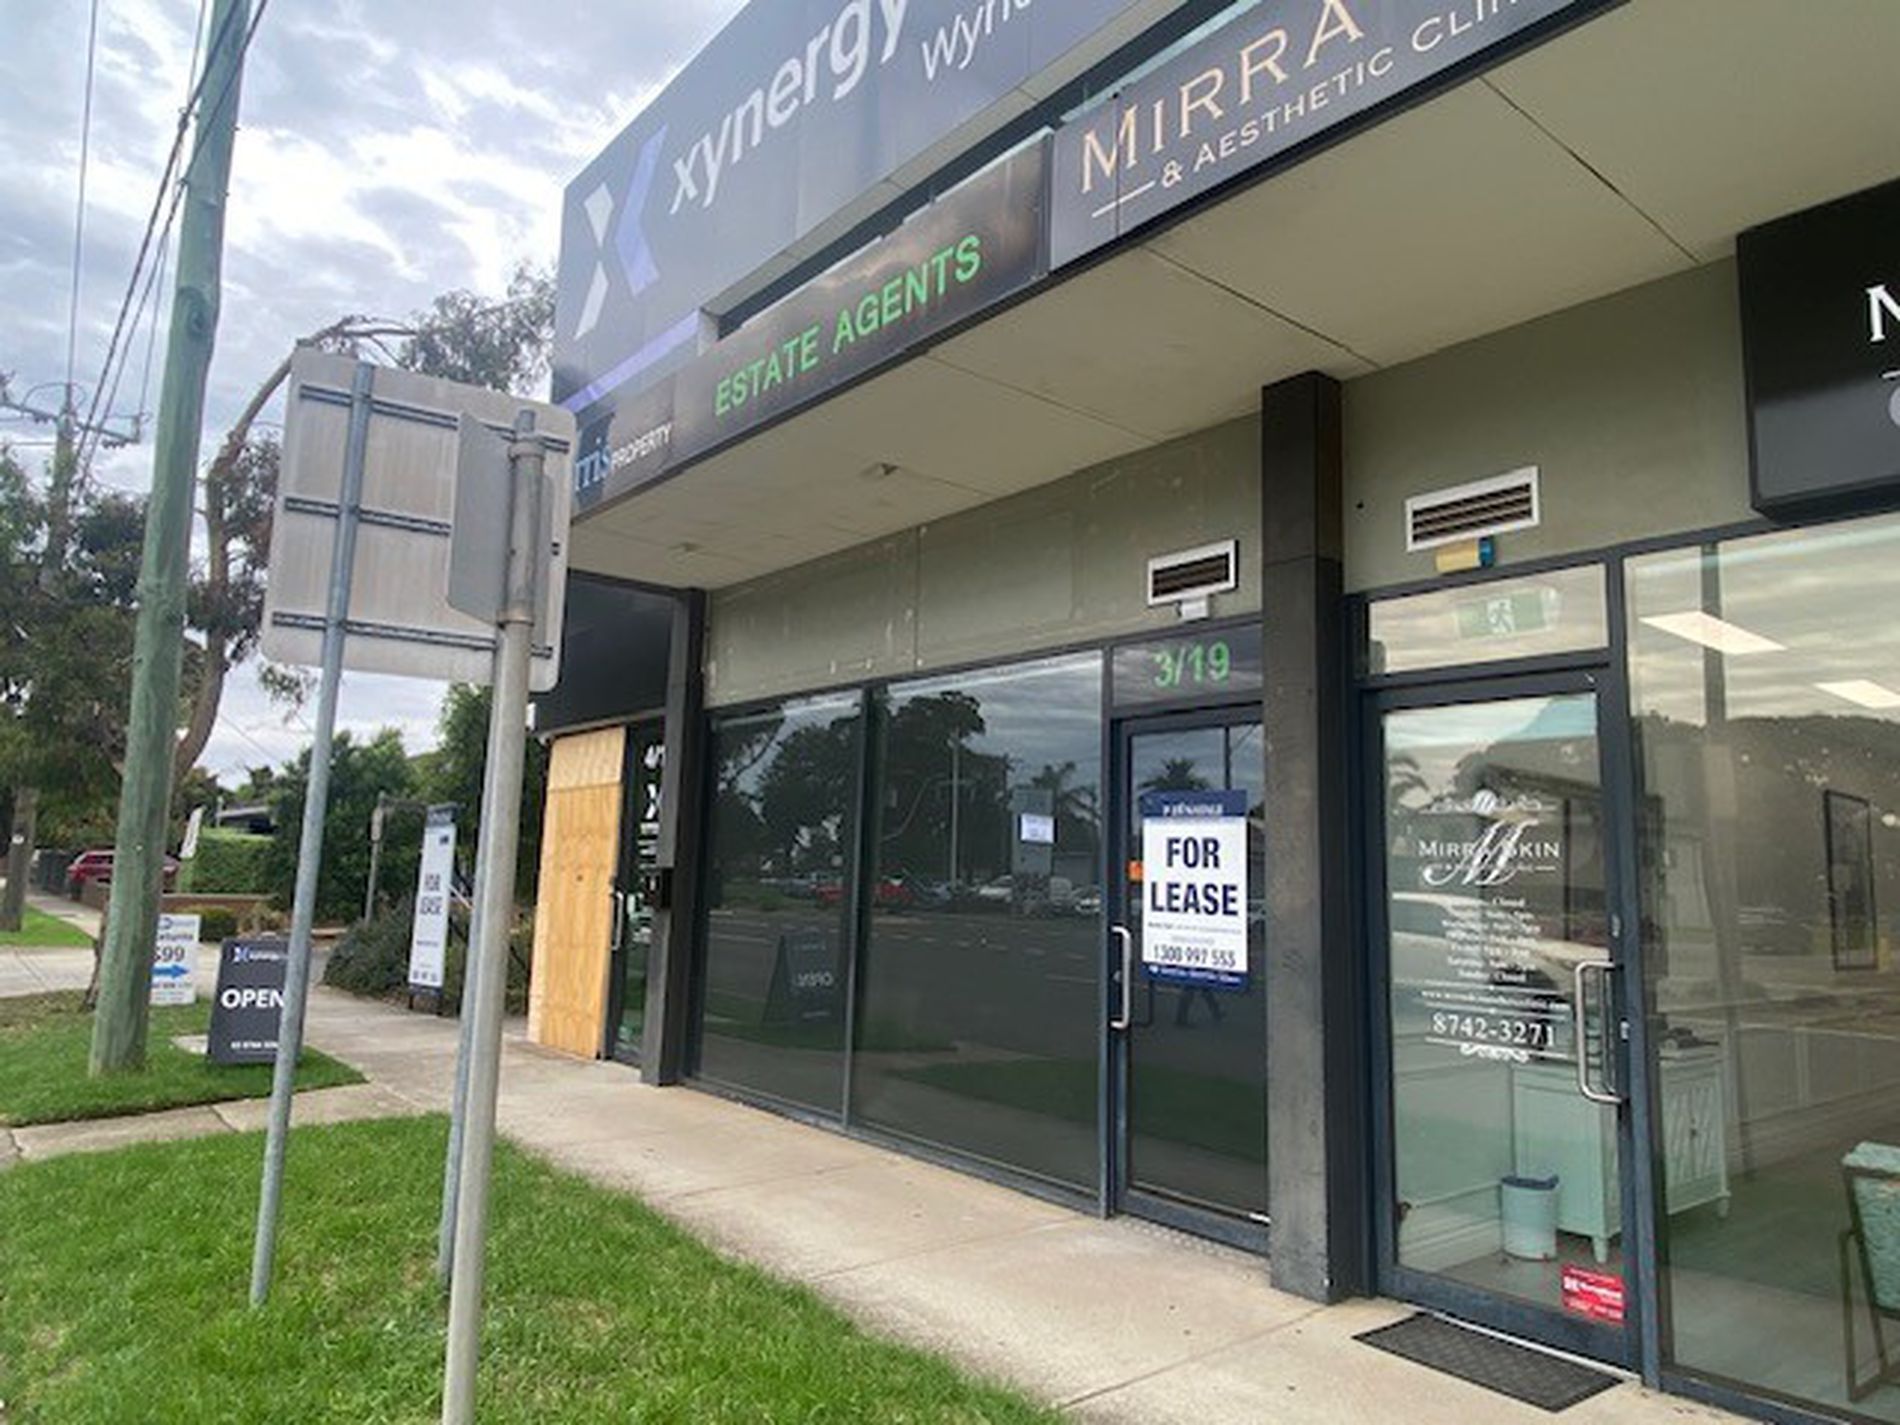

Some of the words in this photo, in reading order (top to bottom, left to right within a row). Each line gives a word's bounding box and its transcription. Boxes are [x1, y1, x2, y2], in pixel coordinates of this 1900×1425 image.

[921, 0, 1033, 81] Wyn
[670, 0, 908, 214] xynergy
[1079, 0, 1365, 194] MIRRA
[1161, 159, 1183, 189] &
[1191, 47, 1396, 173] AESTHETIC
[714, 326, 820, 417] ESTATE
[831, 235, 982, 355] AGENTS
[1153, 641, 1231, 688] 3/19
[1166, 836, 1221, 869] FOR
[1150, 881, 1239, 917] LEASE
[220, 988, 286, 1010] OPEN
[1432, 1011, 1555, 1048] 8742-3271
